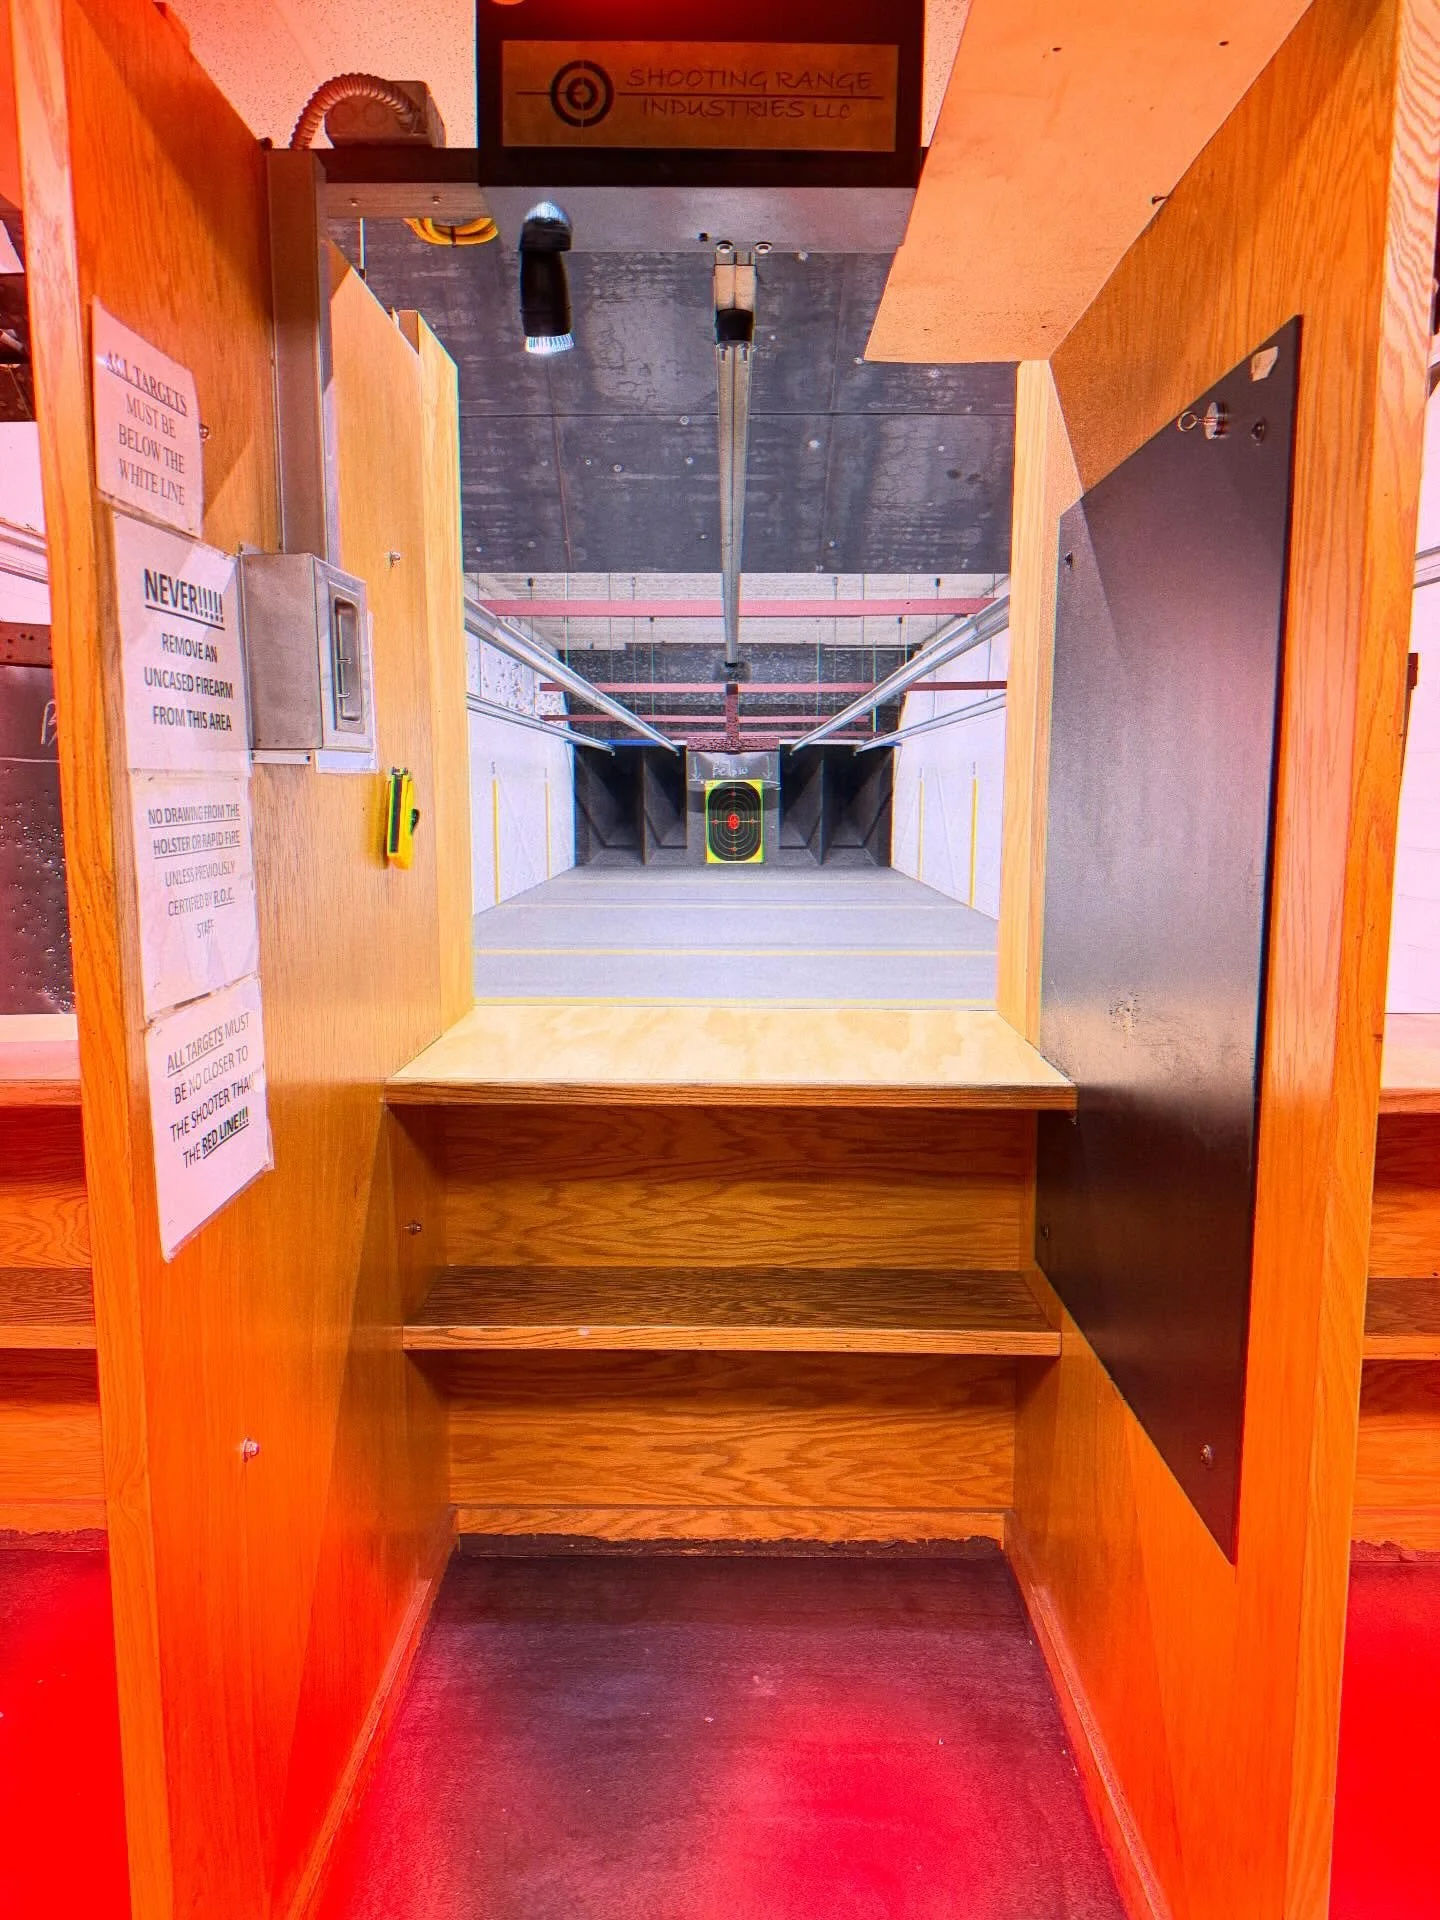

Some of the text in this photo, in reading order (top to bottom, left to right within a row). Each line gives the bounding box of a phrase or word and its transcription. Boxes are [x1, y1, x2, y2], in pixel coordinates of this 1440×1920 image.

[626, 67, 872, 94] SHOOTING RANGE
[642, 98, 804, 118] INDUSTRIES
[106, 350, 187, 414] ALL TARGETS
[126, 393, 176, 439] MUST BE
[119, 424, 185, 474] BELOW THE
[119, 458, 185, 506] WHITE LINE
[144, 568, 224, 623] NEVER!!!!!
[161, 632, 218, 664] REMOVE AN
[144, 667, 233, 700] UNCASED FIREARM
[153, 705, 232, 731] FROM THIS AREA
[148, 803, 240, 825] NO DRAWING FROM THE
[153, 830, 240, 856] HOLSTER OR RAPID FIRE
[165, 860, 235, 887] UNLESS PREVIOUSLY
[168, 894, 204, 917] CERTIFIED
[167, 1012, 250, 1073] ALL TARGETS MUST
[174, 1045, 249, 1104] BE NO CLOSER TO
[169, 1118, 190, 1142] THE
[191, 1088, 230, 1129] SHOOTER
[183, 1106, 249, 1168] THE RED LINE!!!
